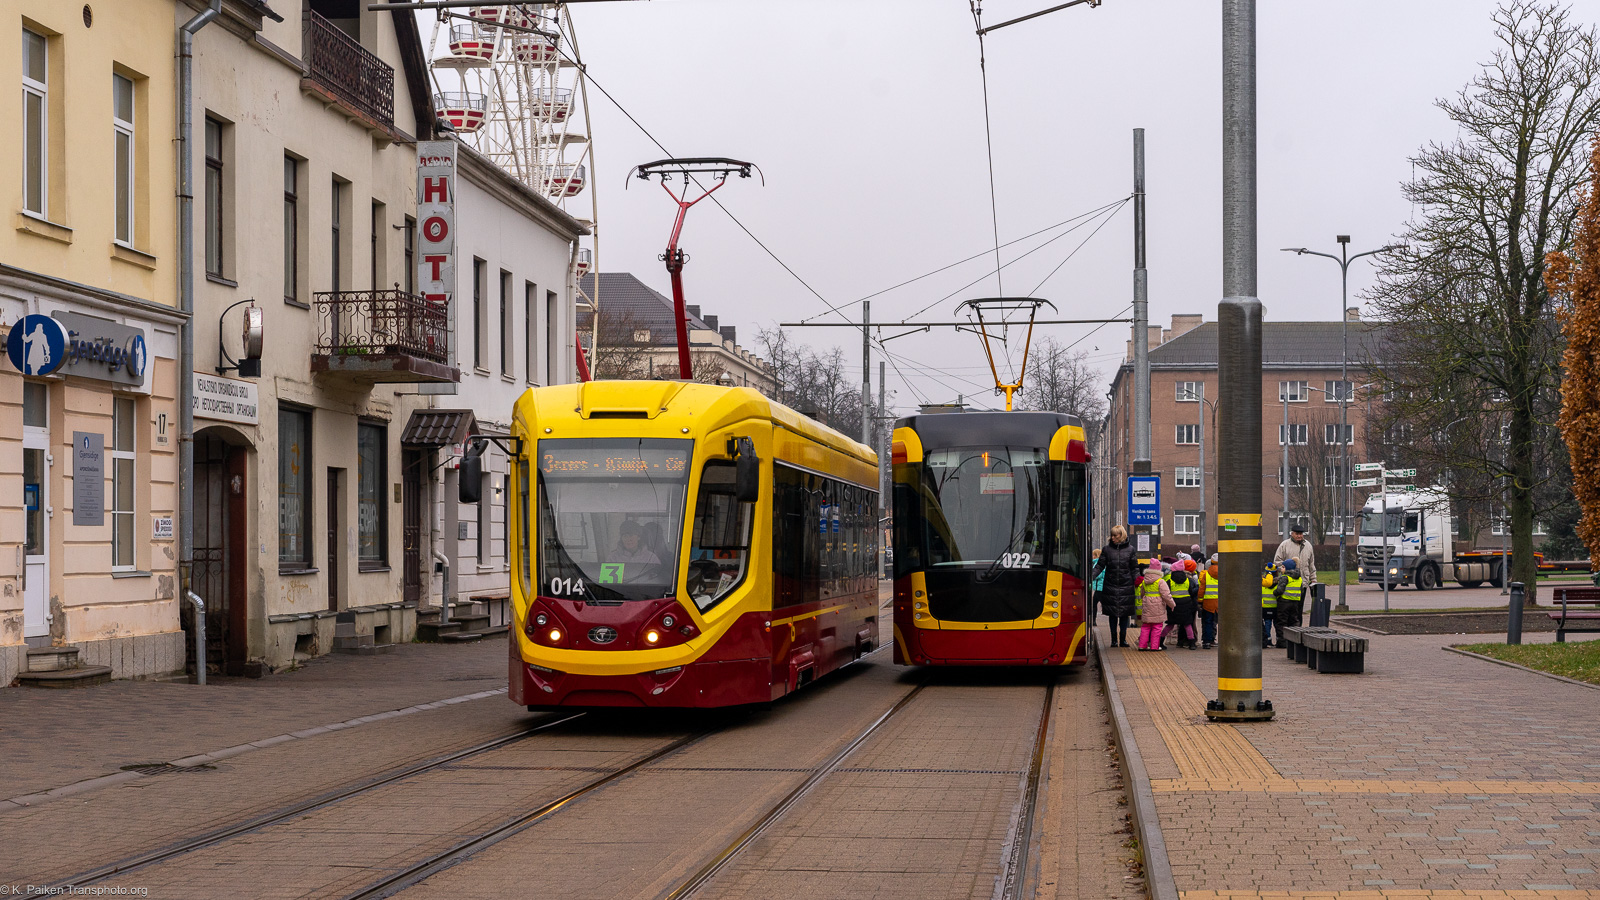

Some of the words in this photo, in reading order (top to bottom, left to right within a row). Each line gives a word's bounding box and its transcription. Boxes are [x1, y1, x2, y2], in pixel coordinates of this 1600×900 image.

[158, 414, 166, 434] 17
[1002, 552, 1030, 568] 022
[605, 565, 620, 583] 3
[550, 577, 585, 596] 014
